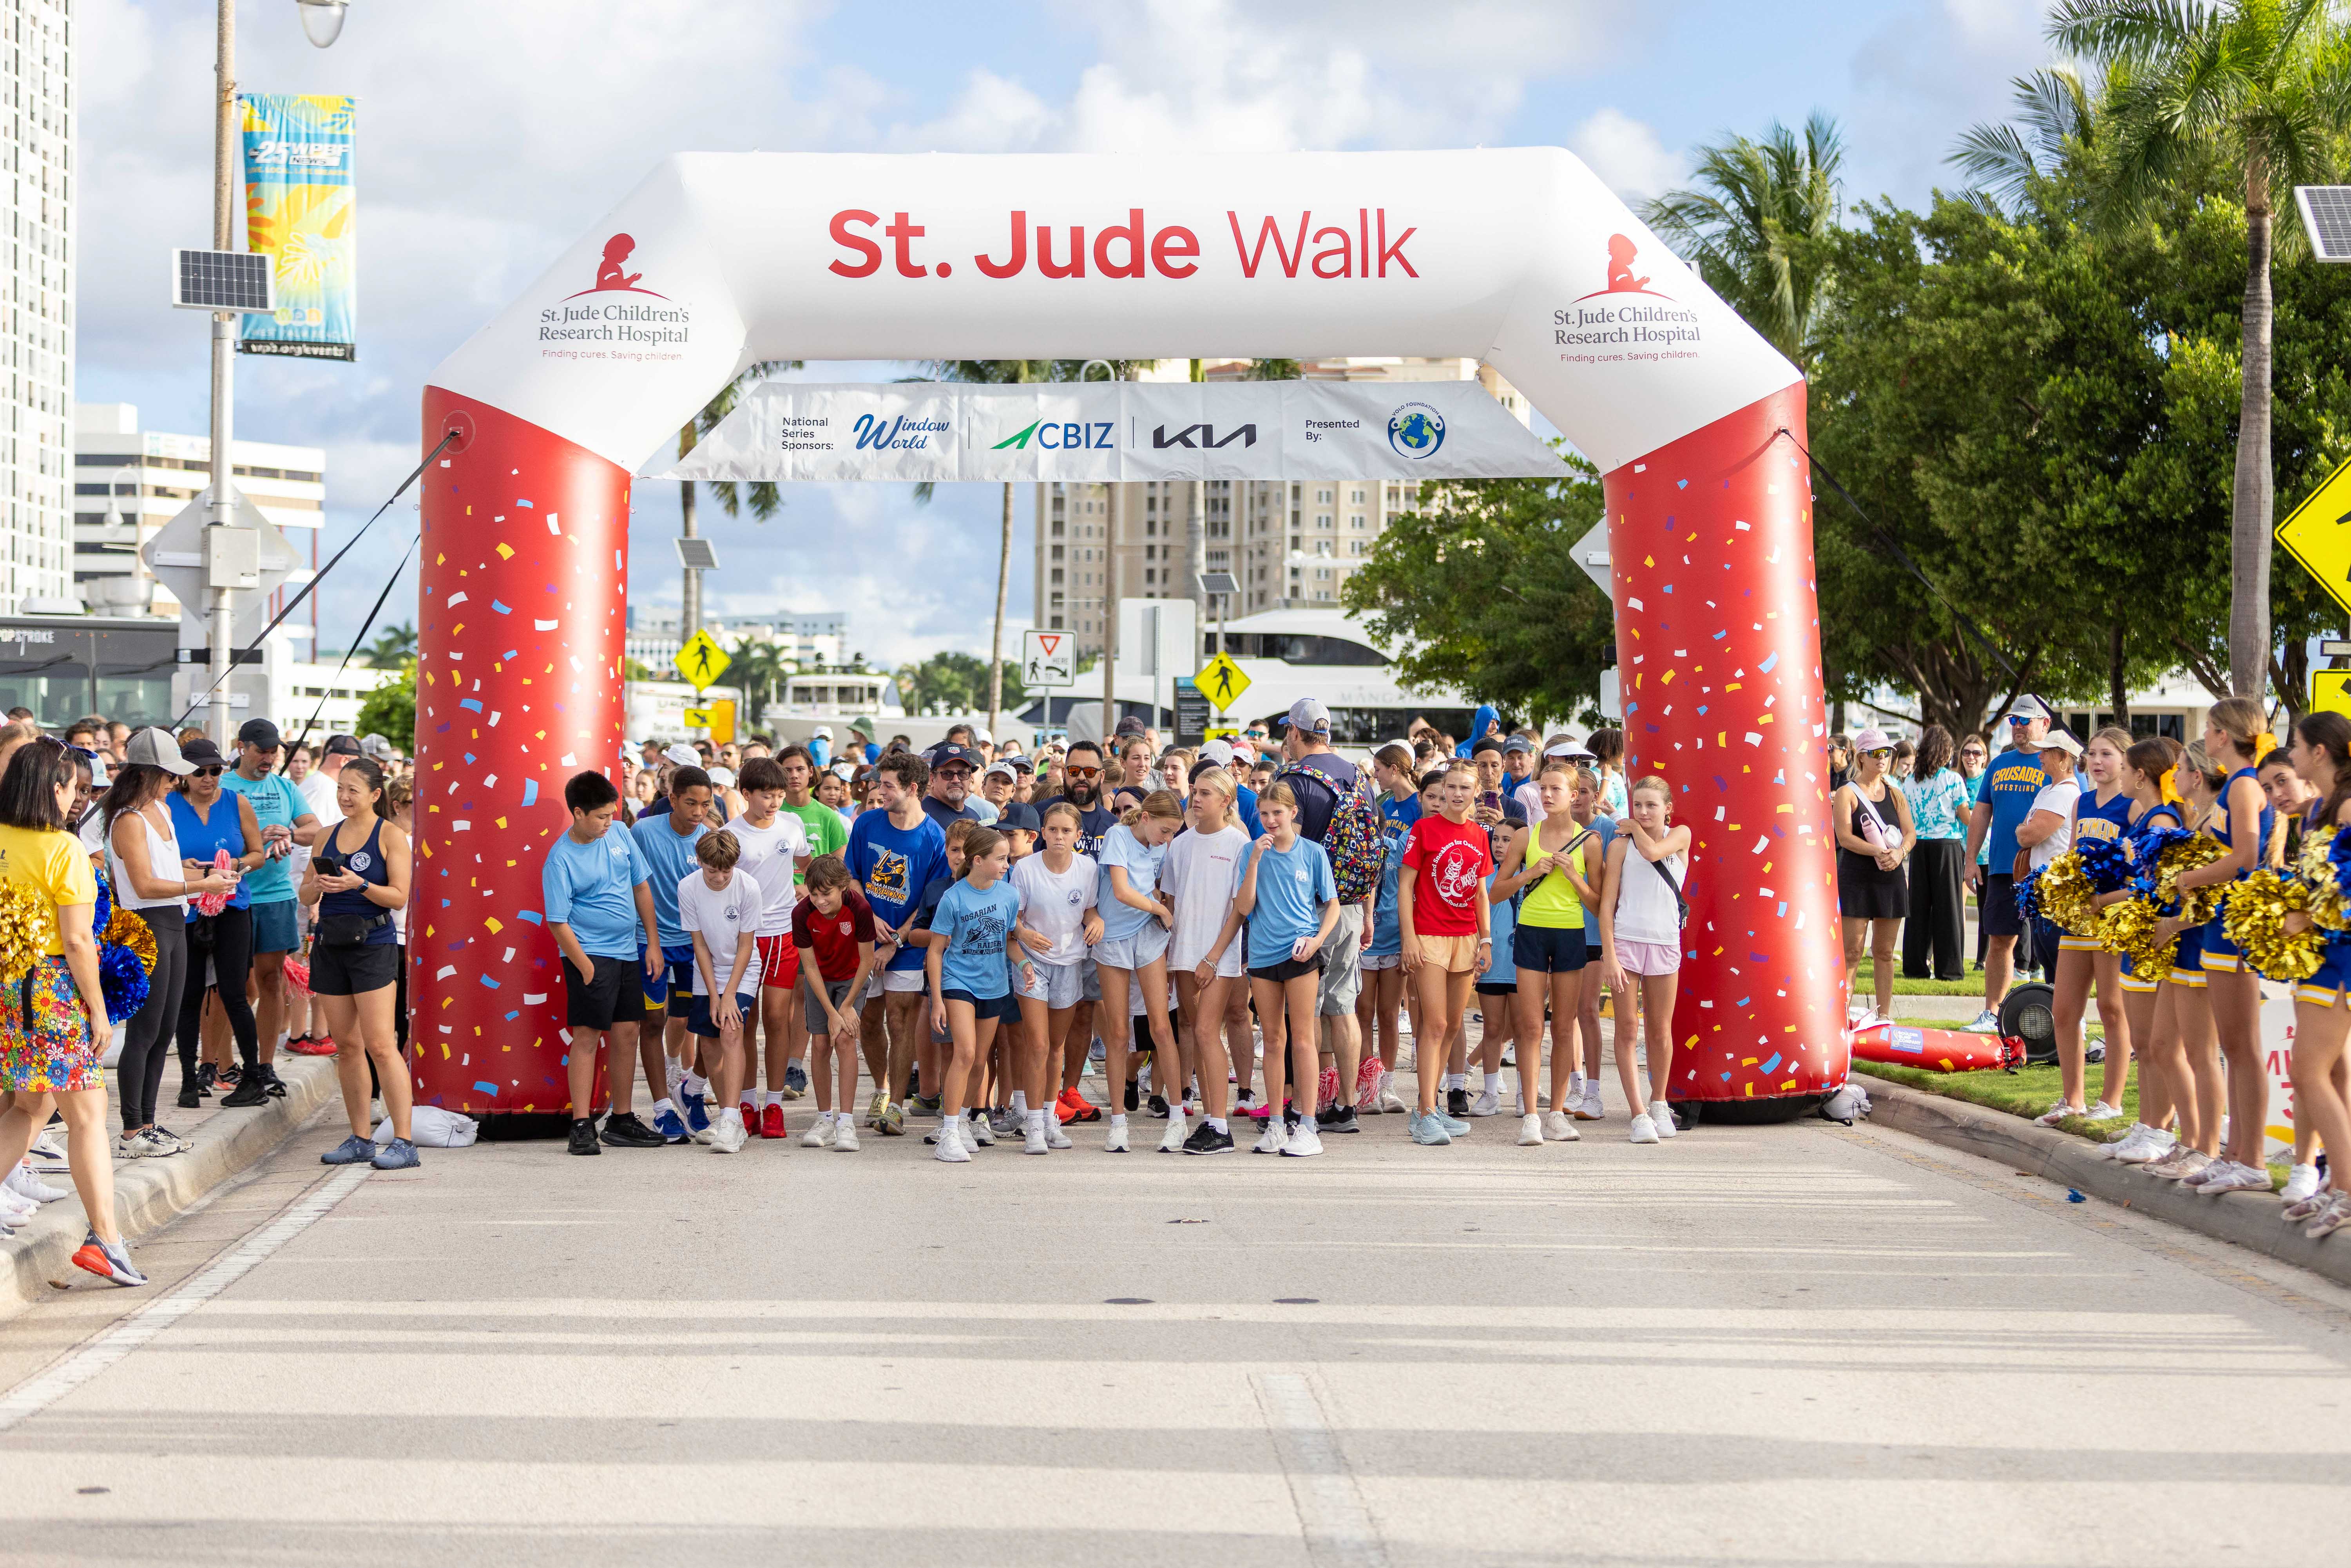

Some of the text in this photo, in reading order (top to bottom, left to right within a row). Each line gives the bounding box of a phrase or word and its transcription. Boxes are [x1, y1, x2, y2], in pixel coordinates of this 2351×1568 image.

[292, 142, 350, 157] WPBF
[828, 208, 1420, 279] St. Jude Walk
[541, 305, 689, 324] St. Jude Children's
[1554, 307, 1697, 328] St. Jude Children's
[539, 325, 688, 346] Research Hospital
[1554, 326, 1701, 345] Research Hospital
[543, 350, 577, 359] Finding
[611, 351, 642, 361] Saving
[645, 352, 684, 360] children.
[1561, 354, 1595, 363] Finding
[1627, 352, 1658, 361] Saving
[1661, 351, 1700, 359] children.
[1392, 402, 1439, 416] VOLO FOUNDATION
[782, 417, 828, 426] National
[1305, 419, 1360, 429] Presented
[782, 429, 815, 438] Series
[853, 414, 950, 450] Window
[1038, 422, 1114, 449] CBIZ
[1306, 432, 1322, 442] By:
[781, 441, 834, 451] Sponsors:
[0, 629, 54, 656] OPSTROKE
[1992, 766, 2045, 787] CRUSADER
[1994, 784, 2035, 792] WRESTLING
[1386, 819, 1409, 832] WMAN
[2076, 818, 2120, 844] EWMAN
[611, 846, 624, 856] RA
[1433, 842, 1454, 864] Sneakers
[687, 855, 698, 865] RA
[1295, 870, 1308, 882] RA
[865, 882, 906, 901] CAMPIONS
[1448, 899, 1458, 907] Food
[960, 904, 997, 923] ROSARIAN
